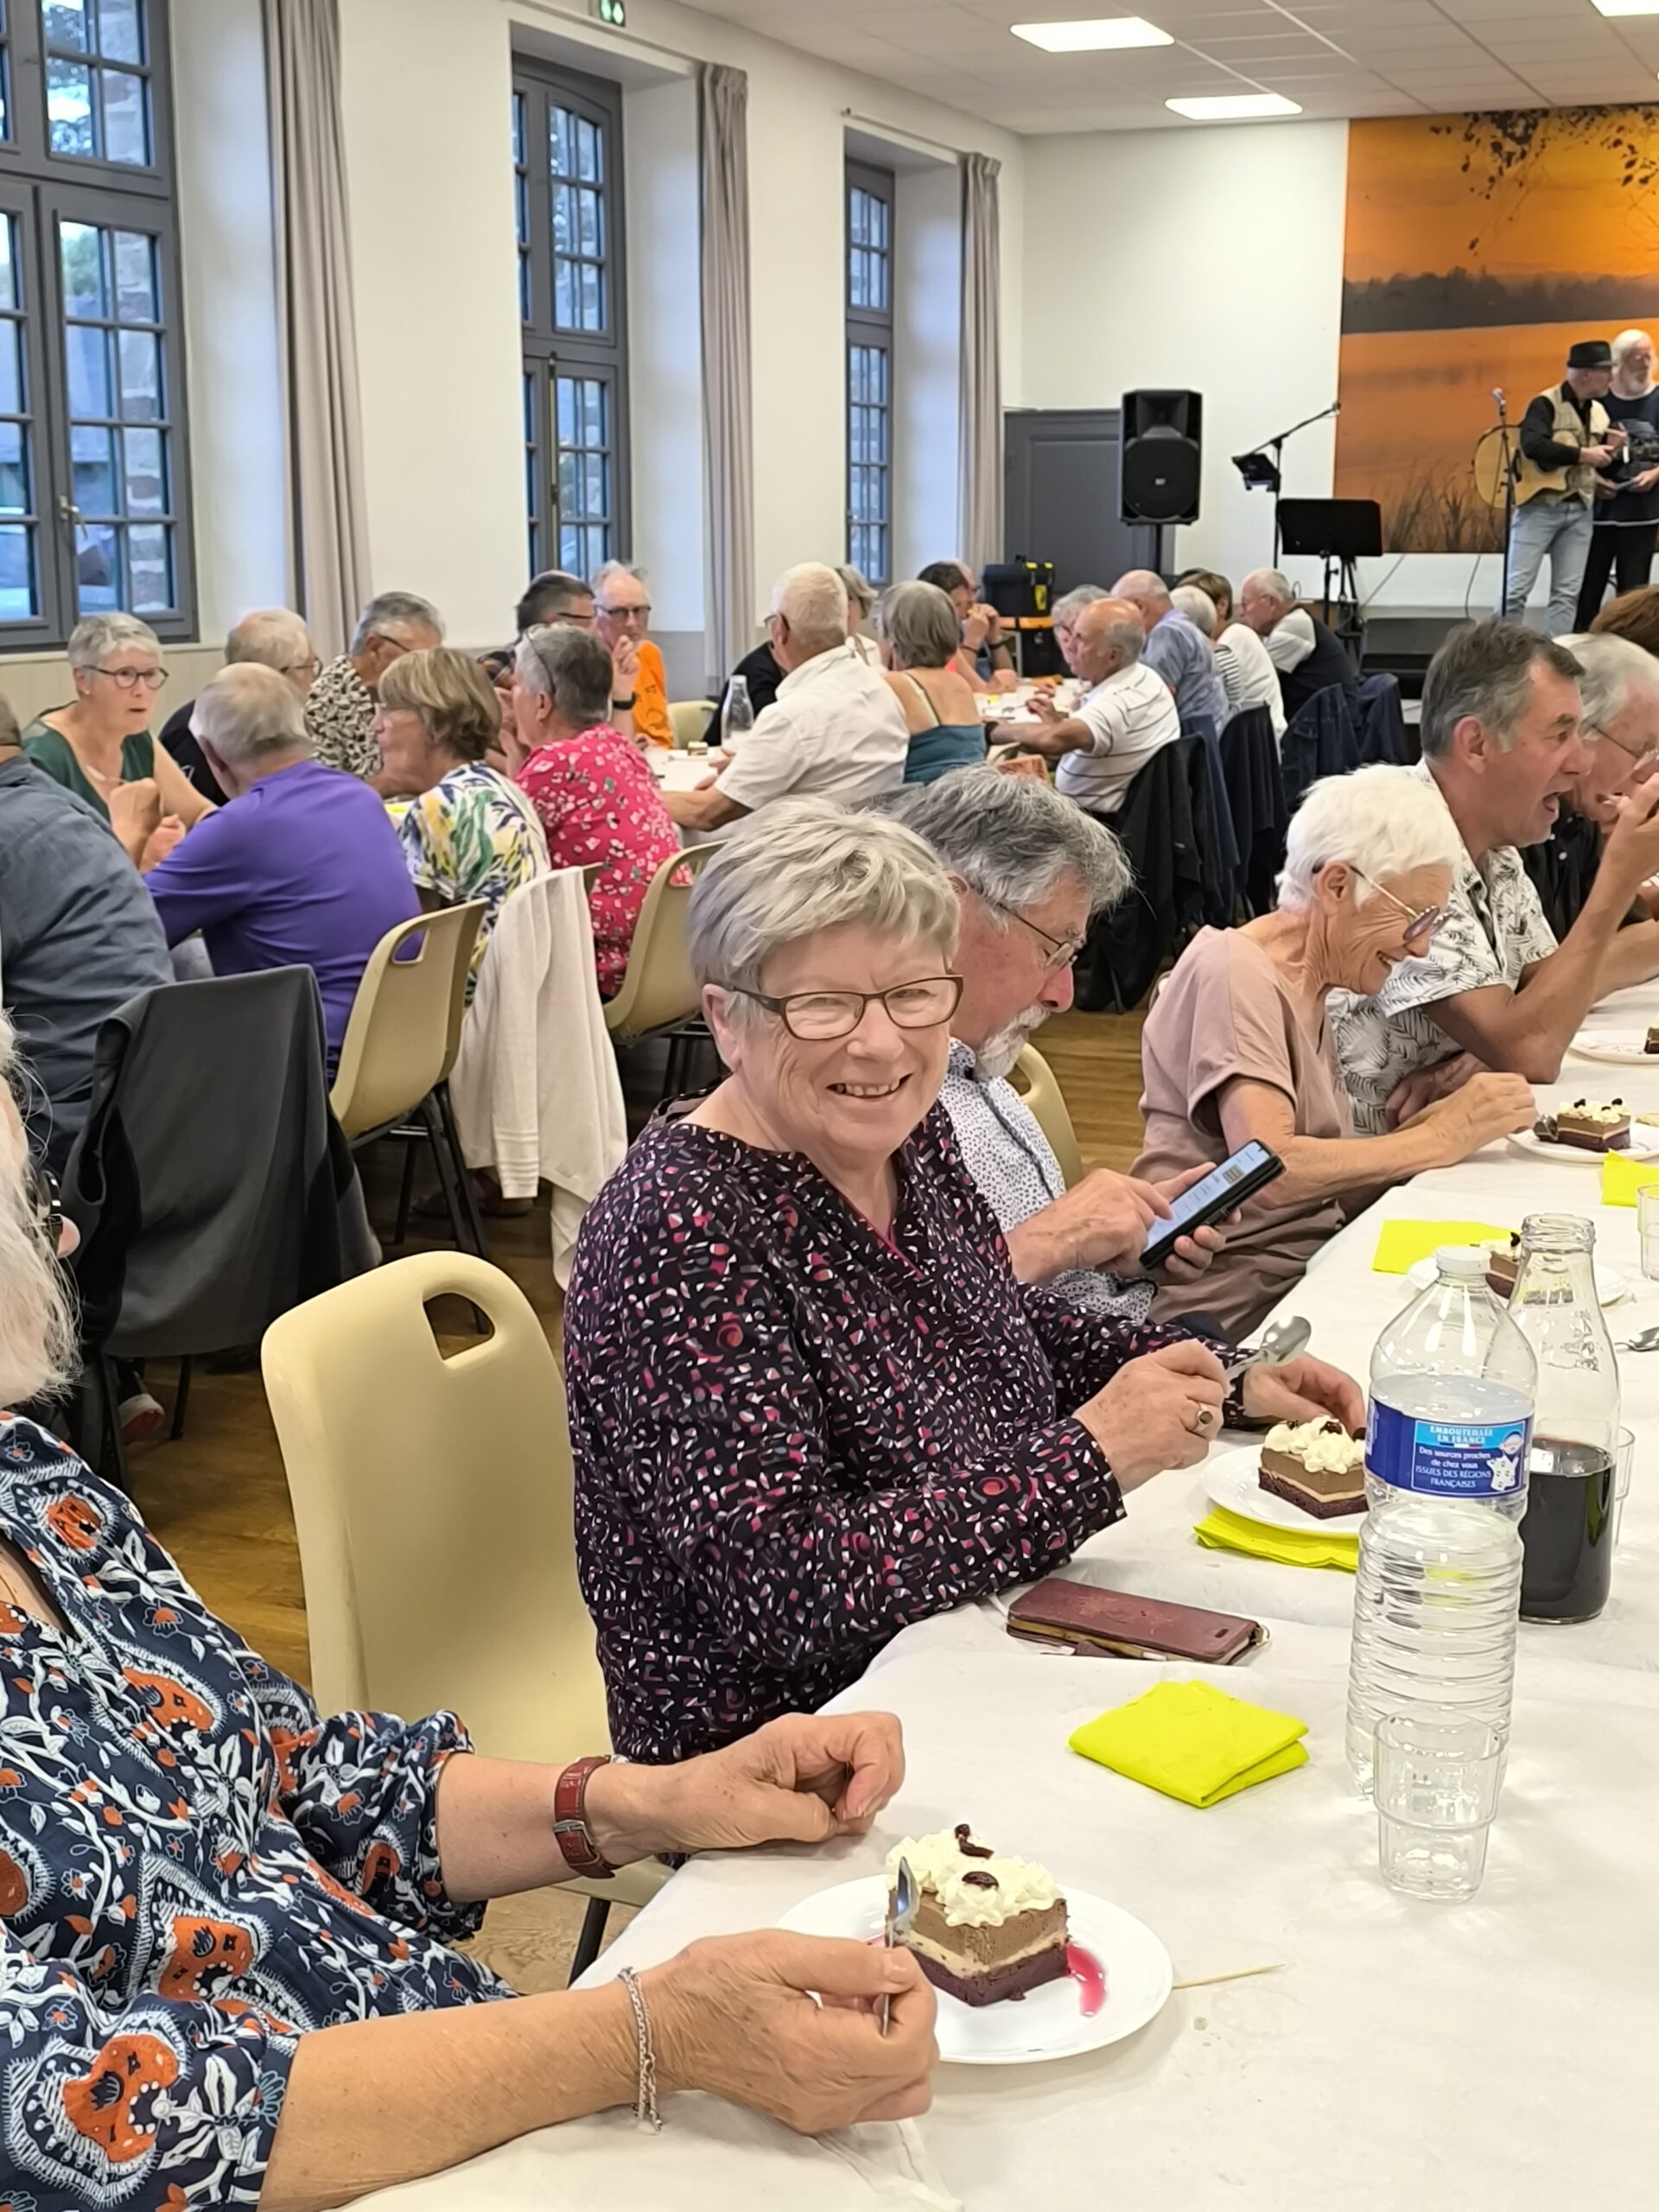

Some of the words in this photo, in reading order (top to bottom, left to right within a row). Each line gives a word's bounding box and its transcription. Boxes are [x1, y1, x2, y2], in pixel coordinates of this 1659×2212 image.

[1452, 1435, 1485, 1444] FRANCE
[1420, 1446, 1433, 1455] Des
[1463, 1452, 1491, 1460] proches
[1415, 1465, 1441, 1476] ISSUES
[1443, 1469, 1459, 1478] DES
[1431, 1477, 1477, 1488] FRANÇAISES
